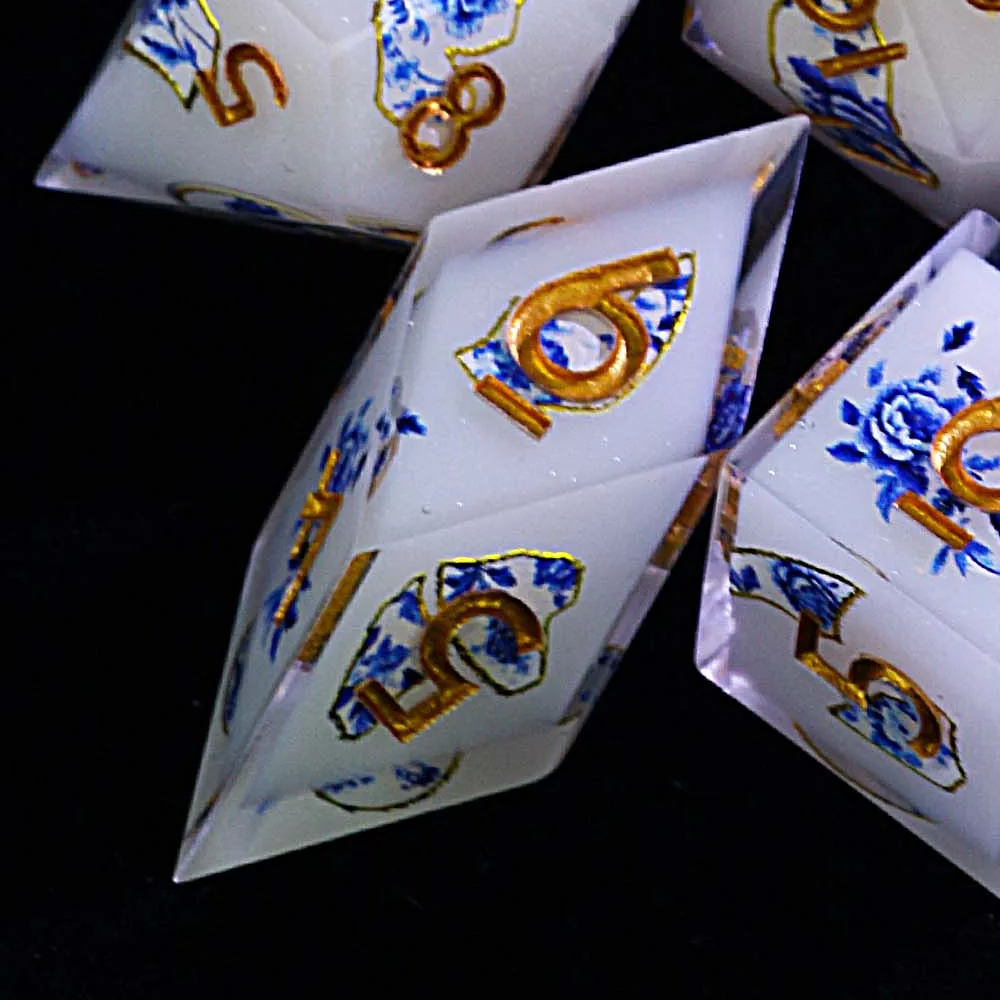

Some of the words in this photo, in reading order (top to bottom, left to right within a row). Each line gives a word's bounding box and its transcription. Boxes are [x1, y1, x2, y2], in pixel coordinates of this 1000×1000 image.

[196, 42, 290, 127] 5
[400, 61, 506, 175] 8
[354, 587, 543, 744] 5
[795, 612, 944, 760] 5
